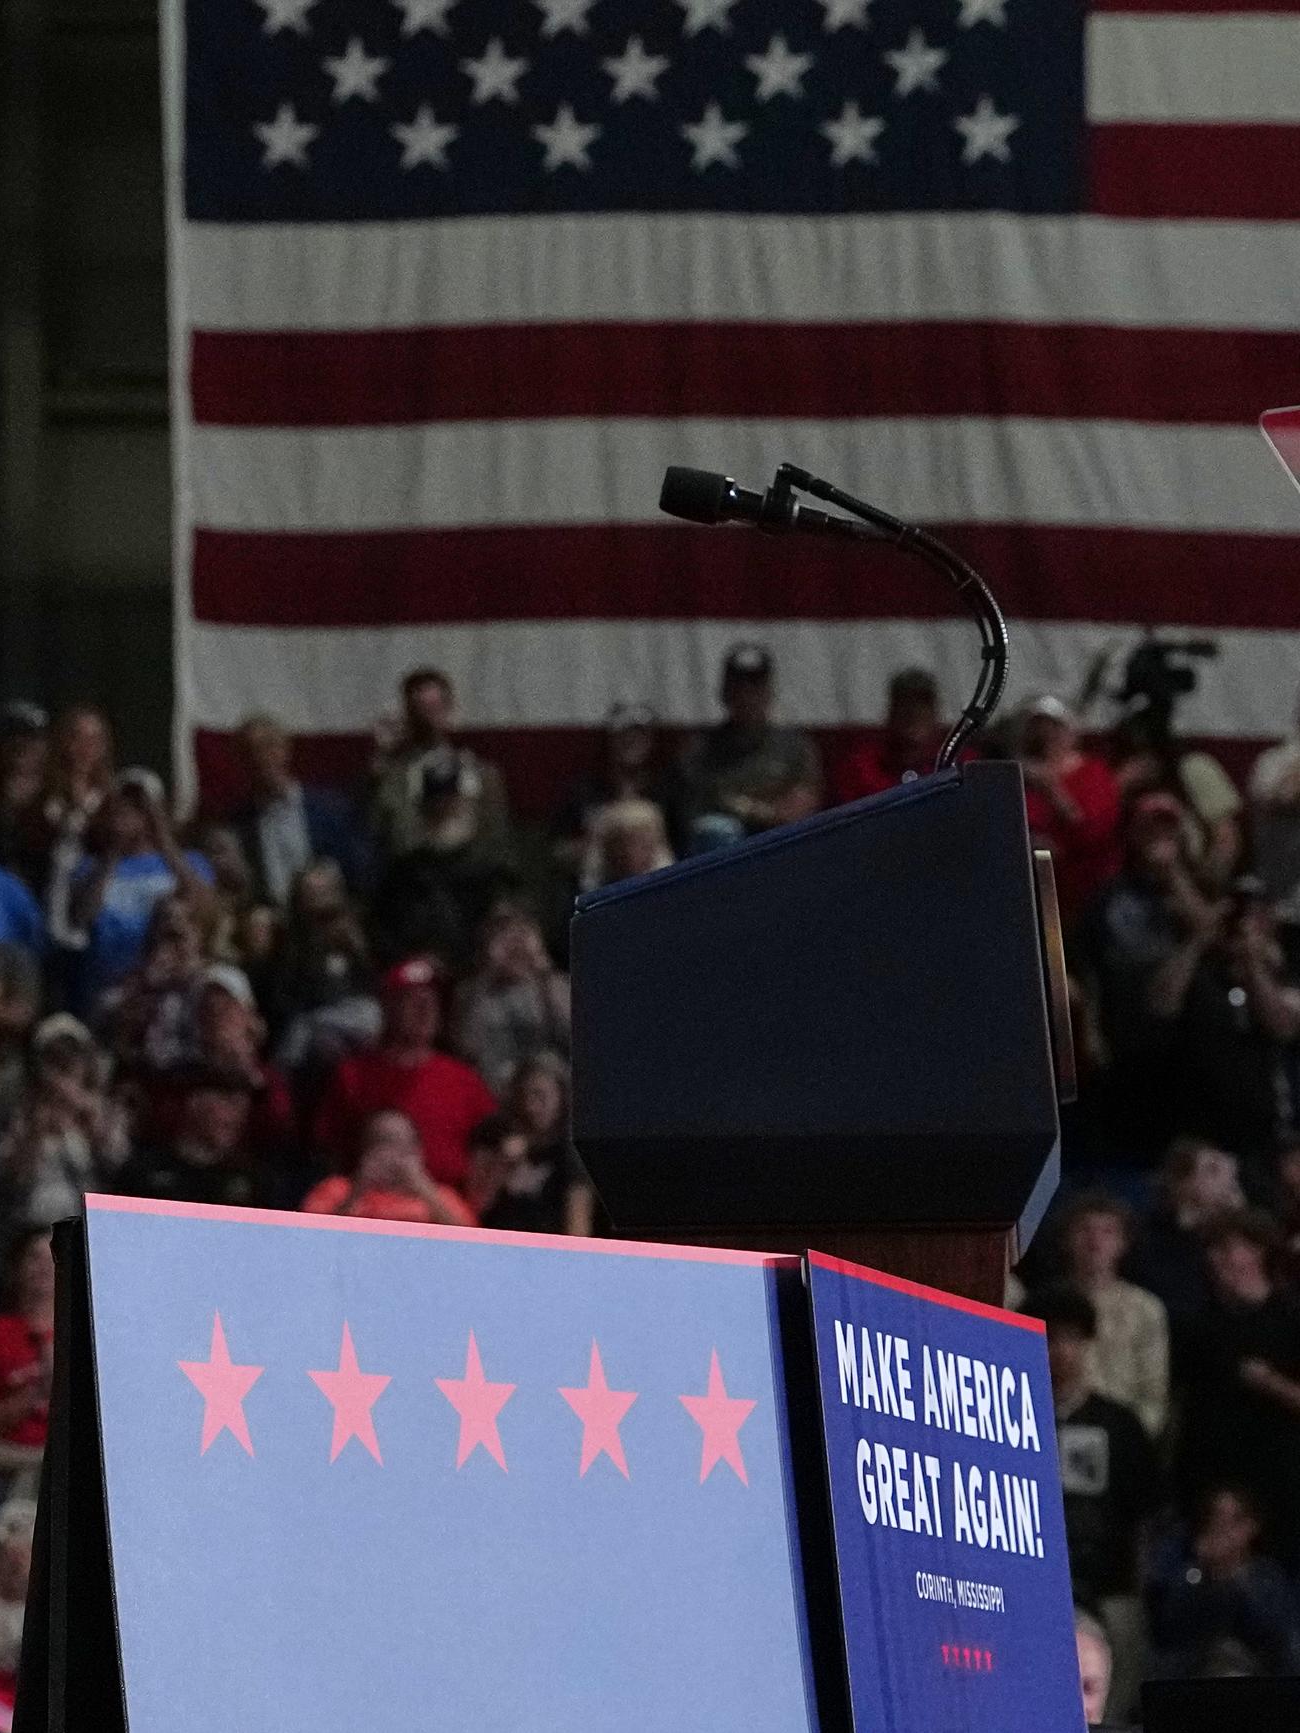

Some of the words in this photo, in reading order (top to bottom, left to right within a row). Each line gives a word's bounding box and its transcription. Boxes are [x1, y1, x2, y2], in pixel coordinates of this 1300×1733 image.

[834, 1319, 916, 1422] MAKE
[922, 1344, 1041, 1453] AMERICA
[856, 1438, 943, 1538] GREAT
[953, 1461, 1045, 1559] AGAIN!
[915, 1570, 957, 1609] CORINTH,
[957, 1579, 1005, 1613] MISSISSIPPI
